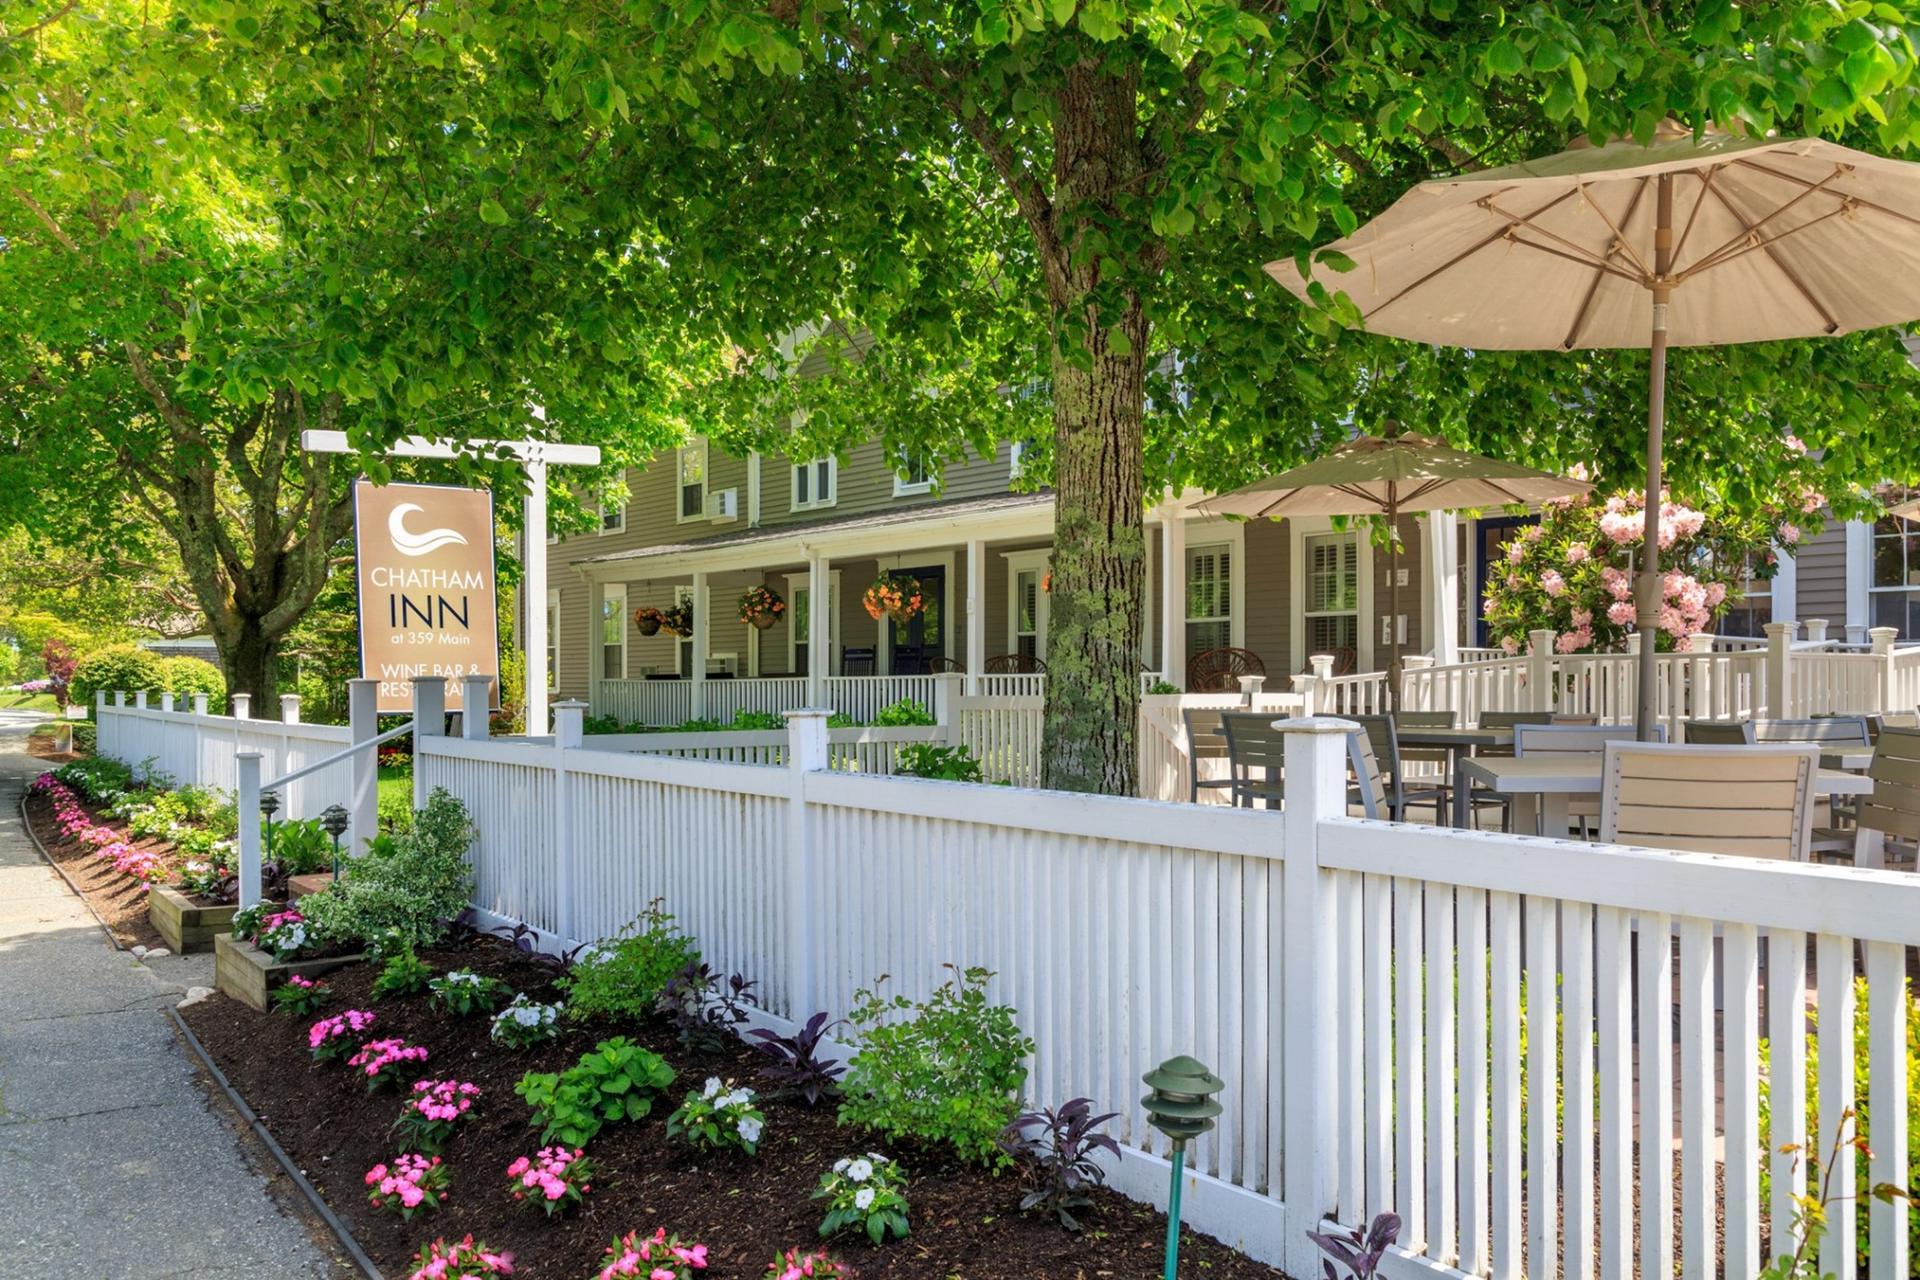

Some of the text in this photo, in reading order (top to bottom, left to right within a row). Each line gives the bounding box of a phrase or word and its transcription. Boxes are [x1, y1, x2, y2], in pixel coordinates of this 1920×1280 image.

[370, 567, 484, 590] CHATHAM
[390, 593, 469, 629] INN
[391, 631, 471, 645] at 359 Main
[380, 663, 481, 679] WINE BAR &
